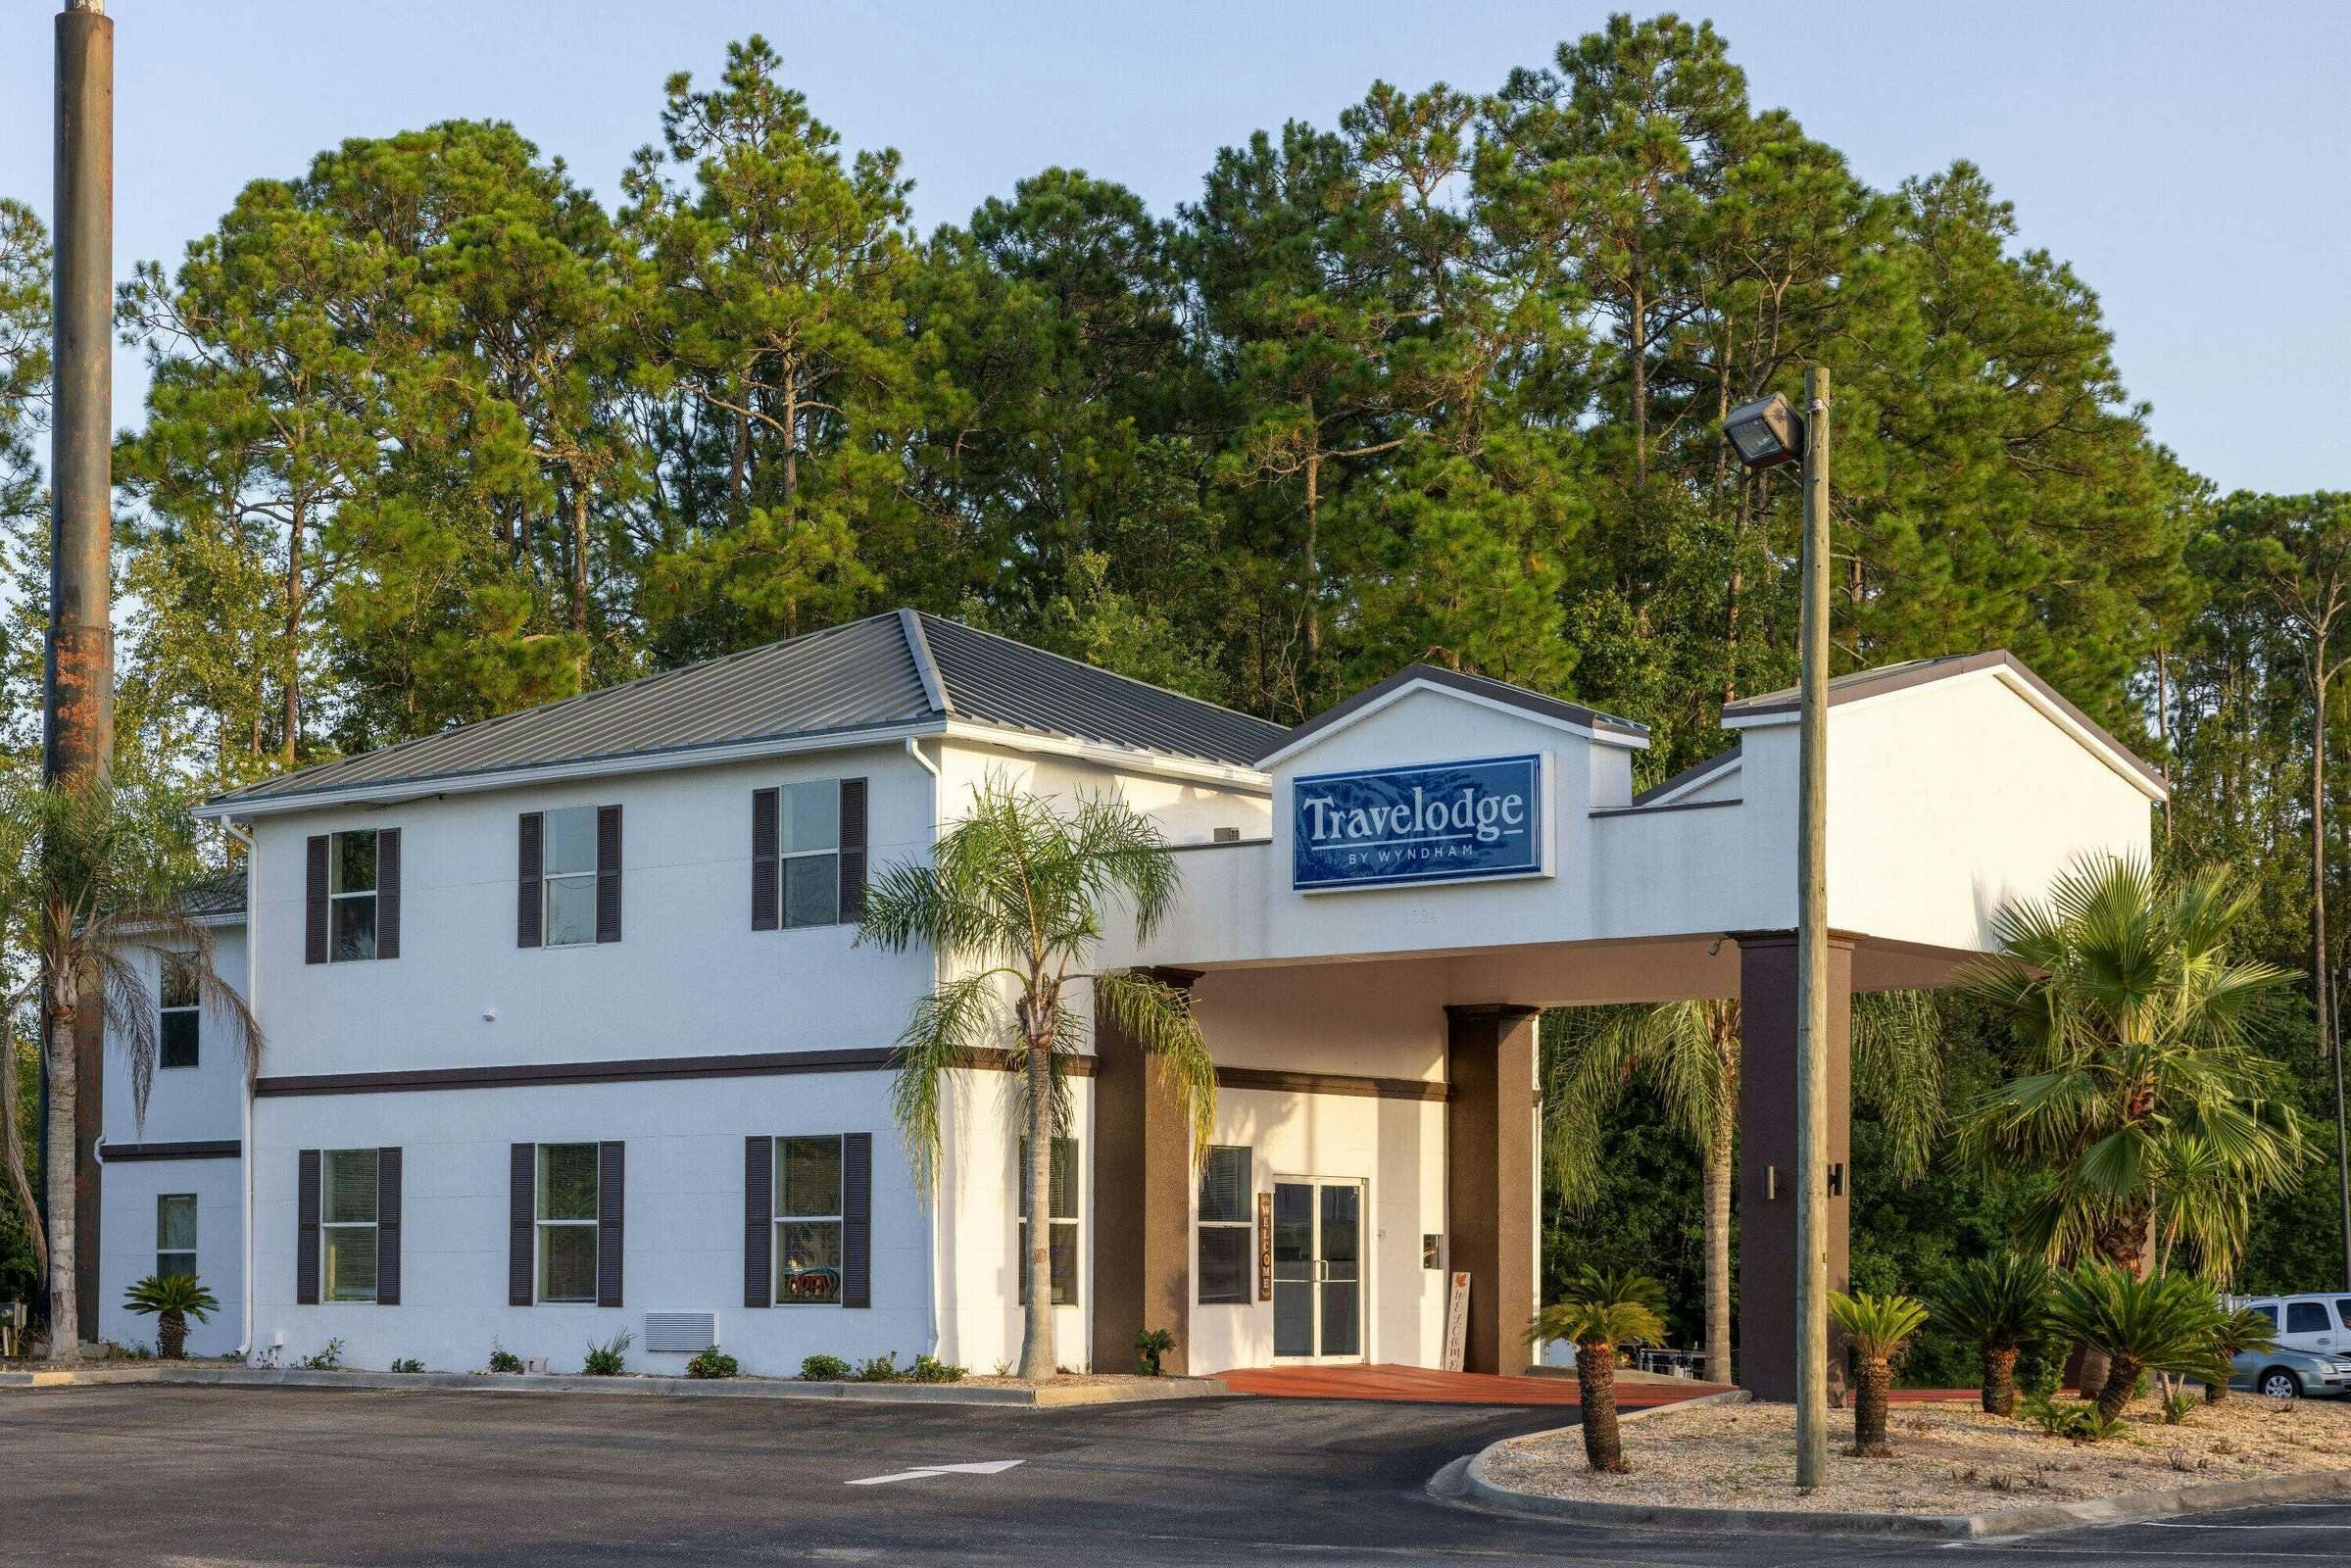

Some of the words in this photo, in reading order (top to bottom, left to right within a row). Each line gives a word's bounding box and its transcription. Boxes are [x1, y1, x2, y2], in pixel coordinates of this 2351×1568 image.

[1302, 786, 1524, 842] Travelodge
[1348, 853, 1369, 865] BY
[1378, 845, 1473, 863] WYNDHAM
[1260, 1204, 1272, 1289] WELCOME
